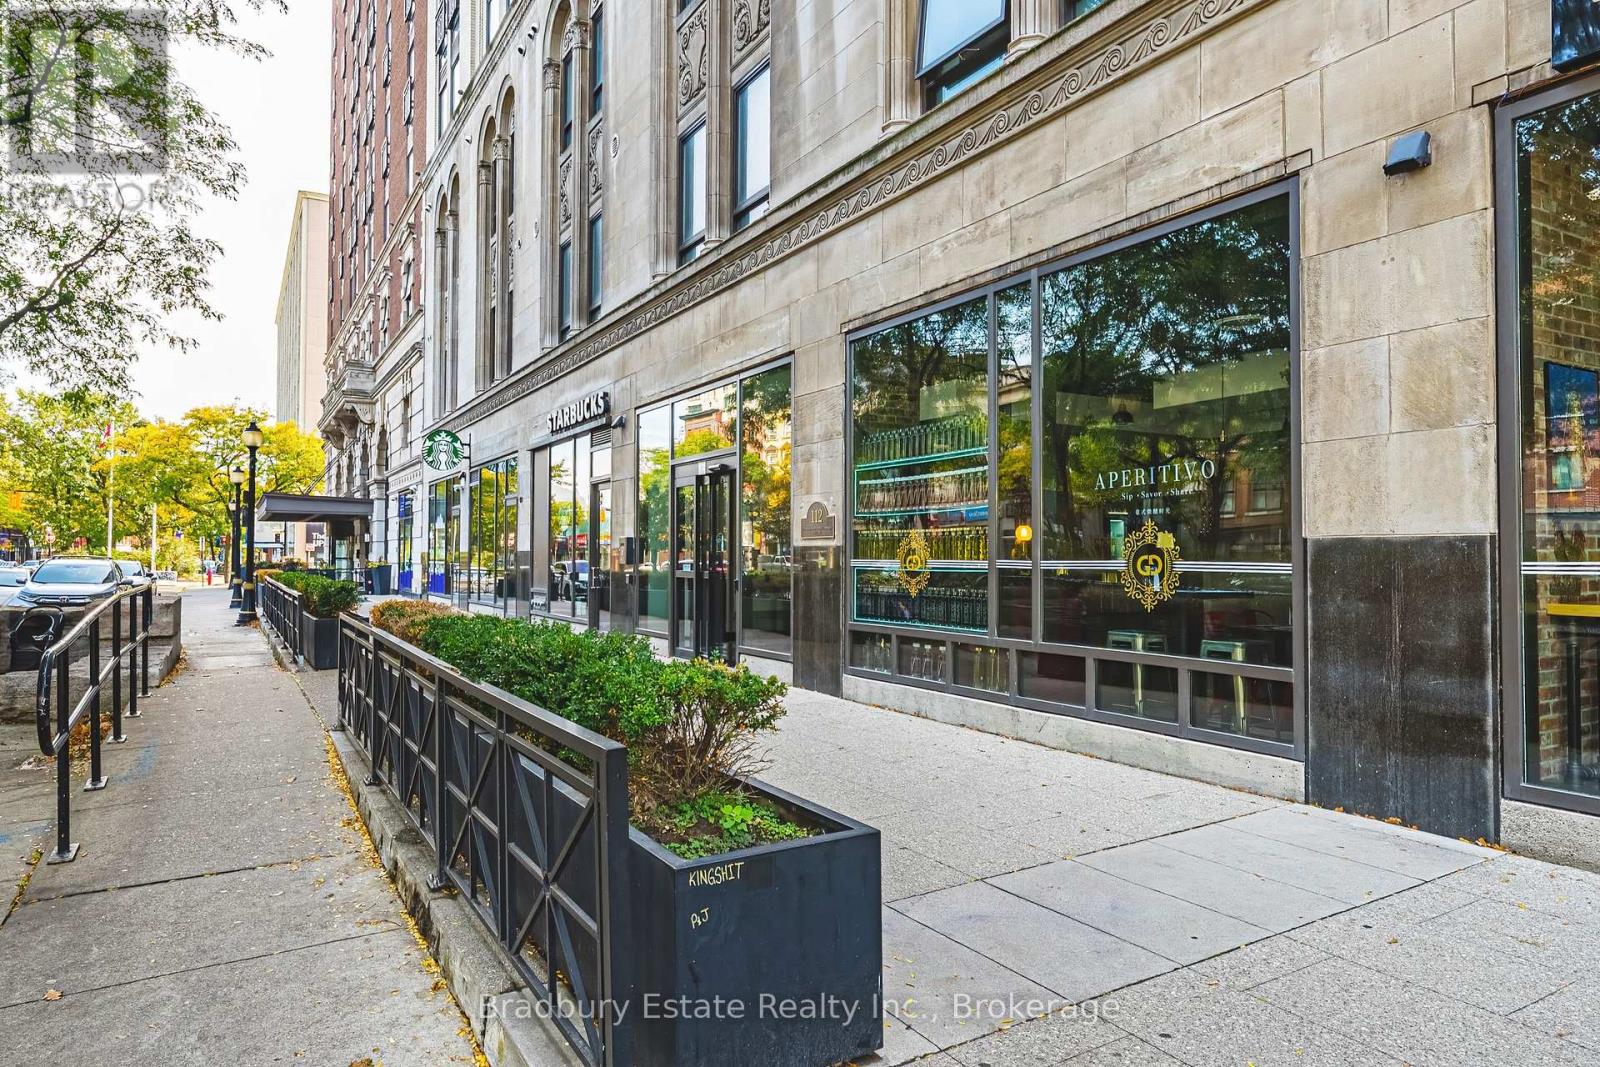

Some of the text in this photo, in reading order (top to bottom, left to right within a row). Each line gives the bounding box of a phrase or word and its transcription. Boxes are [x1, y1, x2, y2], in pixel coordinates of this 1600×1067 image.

[546, 391, 606, 433] STARBUCKS
[1094, 459, 1216, 491] APERITIVO
[1121, 492, 1134, 502] Sip
[811, 509, 824, 523] 112
[688, 861, 745, 887] KINGSHIT
